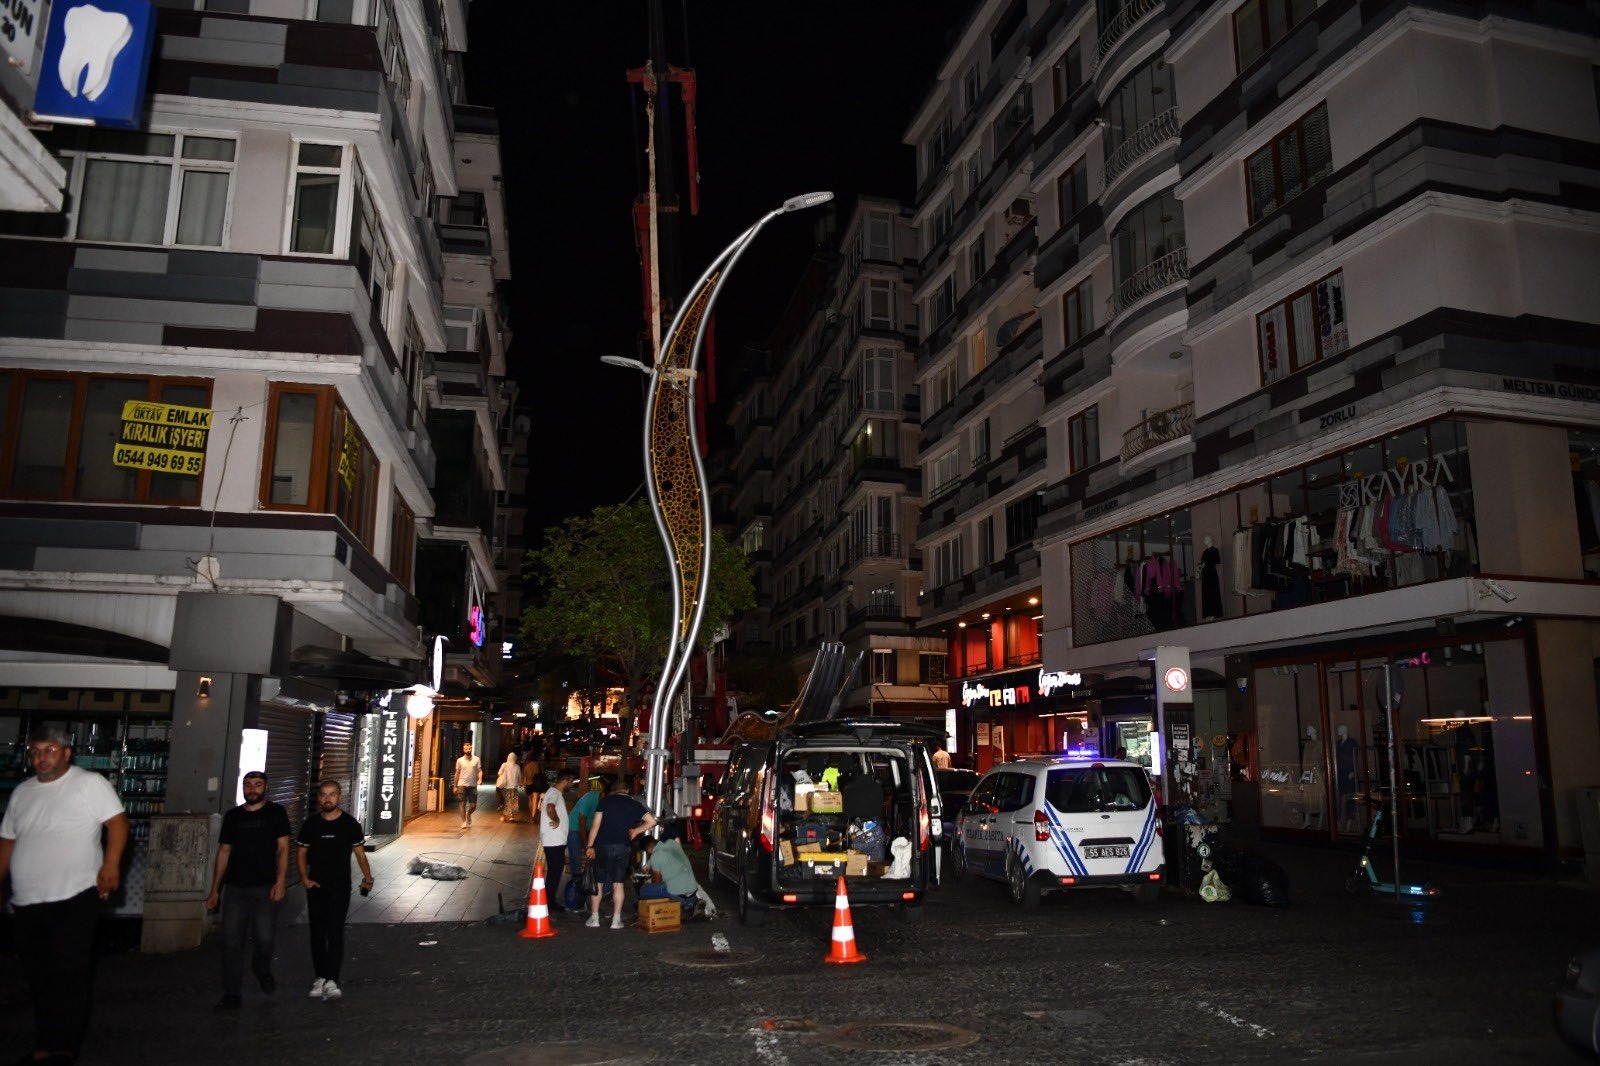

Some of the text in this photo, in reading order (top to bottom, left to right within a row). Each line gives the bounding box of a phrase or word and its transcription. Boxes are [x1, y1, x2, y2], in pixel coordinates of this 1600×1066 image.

[1502, 377, 1556, 395] MELTEM
[133, 407, 209, 426] OKTAV EMLAK
[1319, 405, 1356, 429] ZORLU
[117, 449, 201, 471] 0544 949 69 55
[1360, 454, 1456, 505] KAYRA
[1089, 848, 1099, 857] 55
